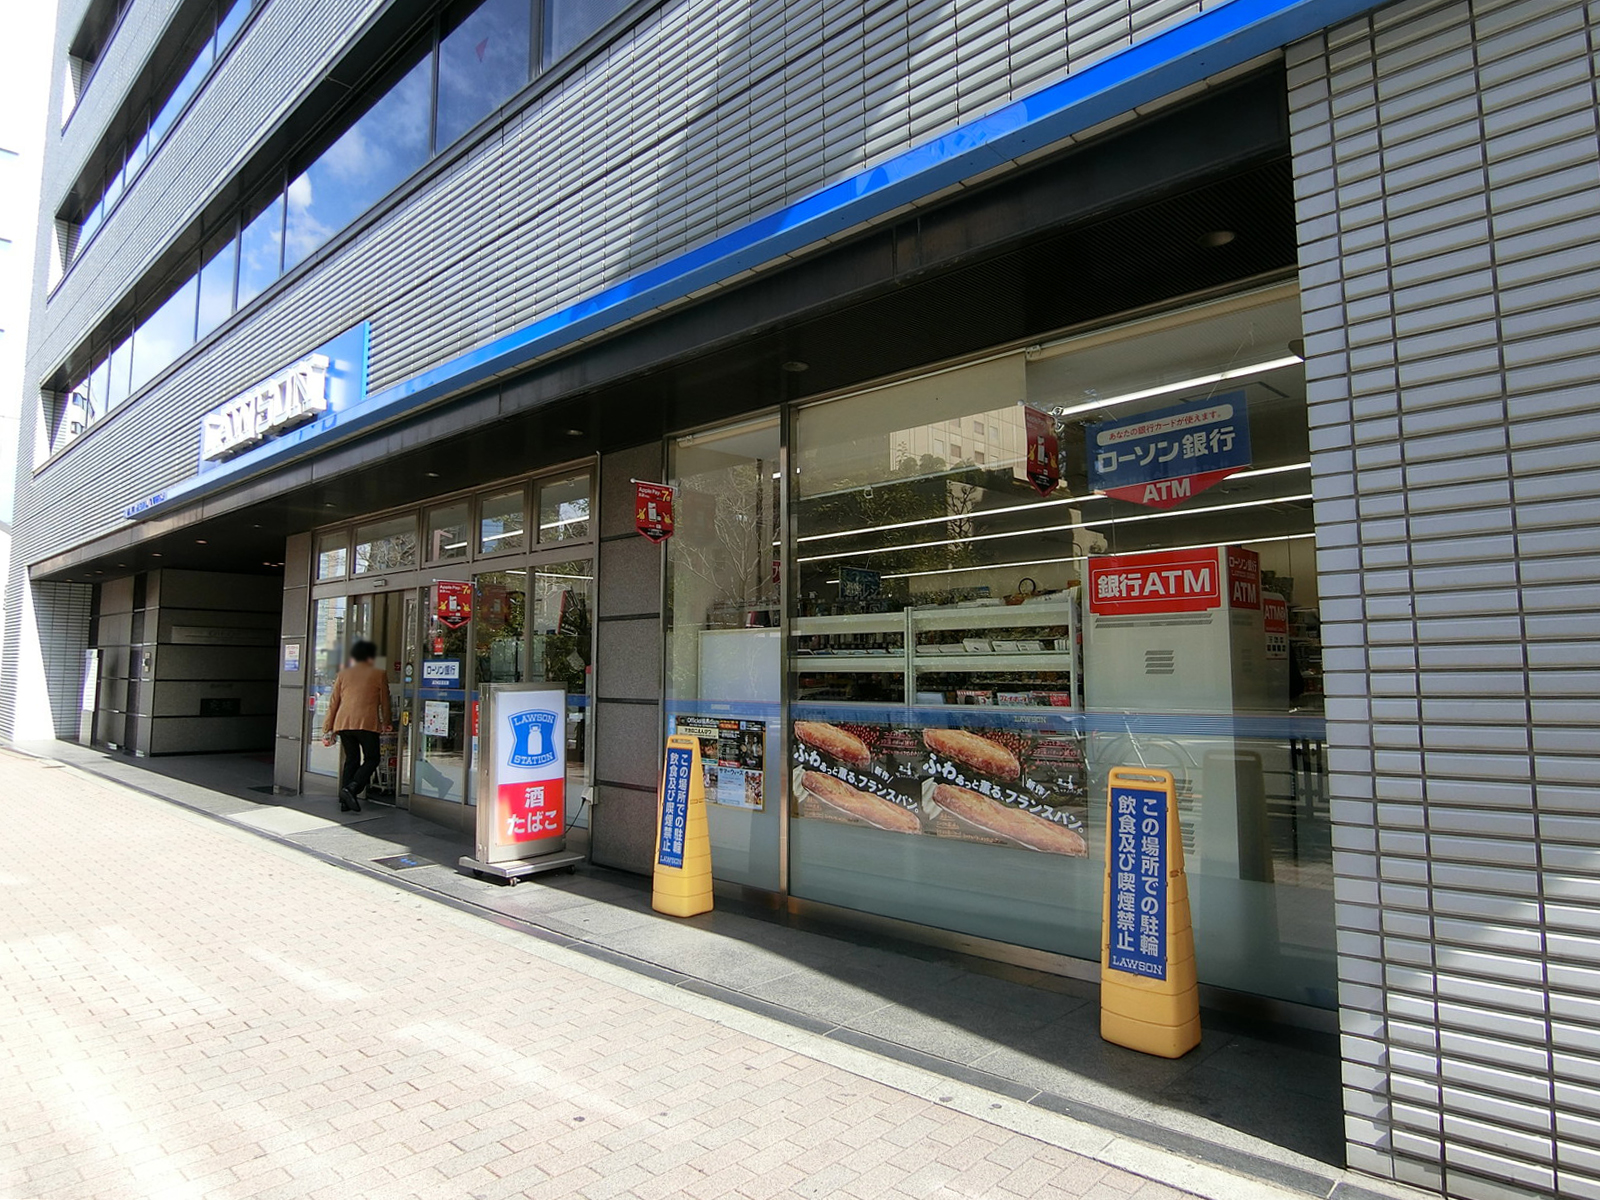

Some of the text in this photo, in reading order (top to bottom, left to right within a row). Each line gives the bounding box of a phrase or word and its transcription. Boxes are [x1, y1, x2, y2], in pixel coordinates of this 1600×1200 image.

[1107, 410, 1223, 441] あなたの銀行カードが使えます。
[1097, 425, 1236, 473] ローソン銀行
[1142, 477, 1192, 504] ATM
[1097, 568, 1211, 598] 銀行ATM
[1233, 581, 1257, 604] ATM
[514, 713, 555, 726] LAWSON
[513, 752, 554, 765] STATION
[524, 786, 545, 808] 酒
[662, 752, 679, 852] 飲食及び喫煙禁止
[672, 754, 689, 854] この場所での駐輪
[506, 809, 558, 836] たばこ
[1116, 795, 1136, 952] 飲食及び喫煙禁止
[1139, 798, 1160, 956] この場所での駐輪
[1112, 955, 1163, 975] LAWSON
